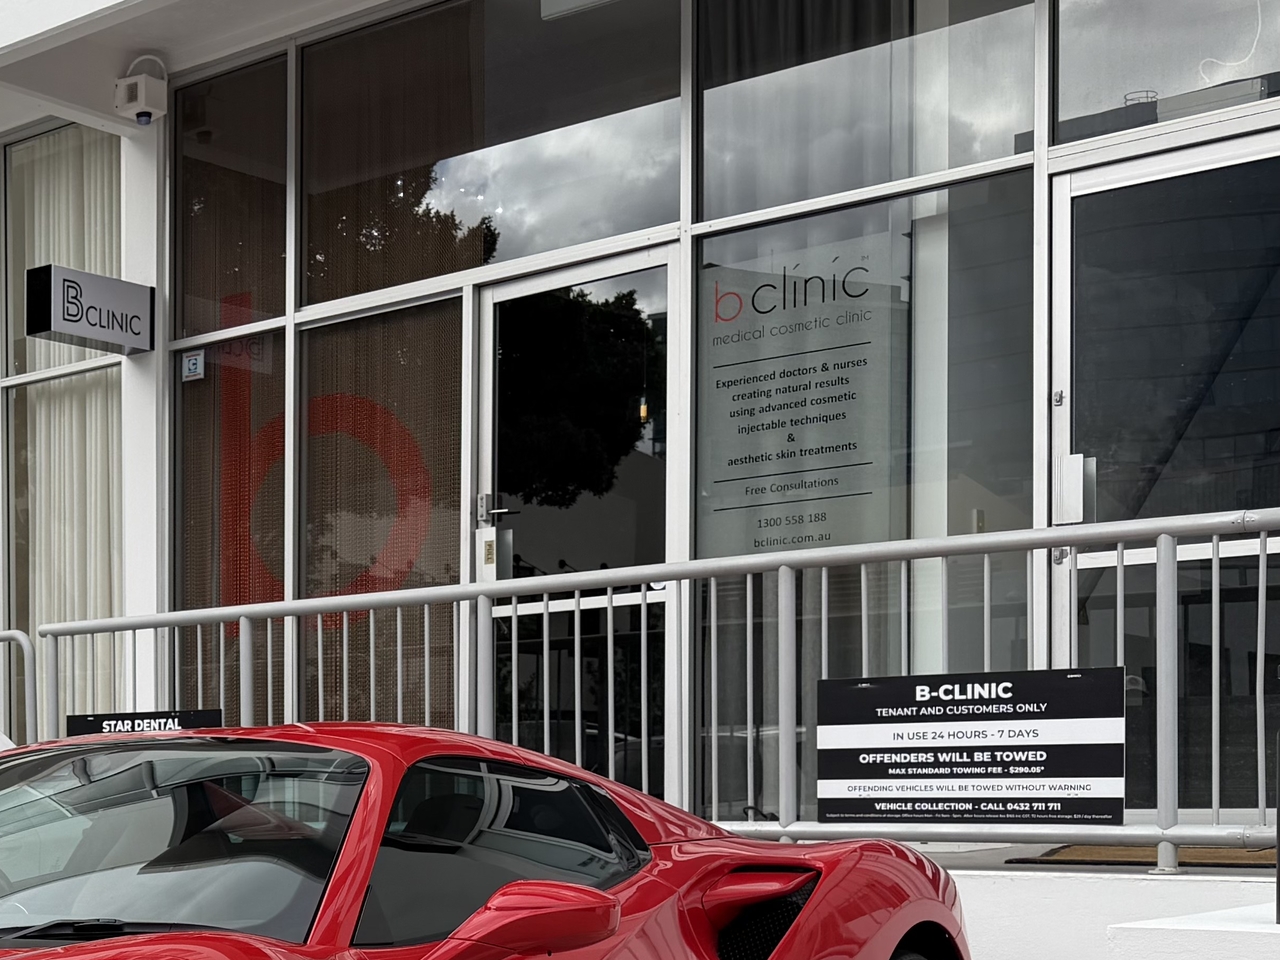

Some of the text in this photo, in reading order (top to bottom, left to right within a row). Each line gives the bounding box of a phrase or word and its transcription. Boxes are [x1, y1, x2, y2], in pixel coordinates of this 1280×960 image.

[713, 310, 872, 346] medical cosmetic clinic
[716, 358, 868, 389] Experienced doctors & nurses
[732, 376, 850, 402] creating natural results
[729, 391, 857, 418] using advanced cosmetic
[737, 411, 847, 435] injectable techniques
[787, 433, 796, 443] &
[728, 441, 857, 466] aesthetic skin treatments
[745, 477, 839, 496] Free Consultations
[758, 512, 827, 528] 1300 558 188
[754, 532, 831, 548] bclinic.com.au
[915, 682, 1013, 701] B-CLINIC
[876, 703, 1047, 717] TENANT AND CUSTOMERS ONLY
[102, 718, 182, 732] STAR DENTAL
[893, 732, 904, 741] IN
[907, 731, 928, 740] USE
[931, 731, 945, 740] 24
[947, 730, 988, 740] HOURS
[997, 730, 1005, 738] 7
[1008, 729, 1039, 739] DAYS
[859, 751, 1047, 764] OFFENDERS WILL BE TOWED
[908, 767, 951, 775] STANDARD
[952, 767, 986, 775] TOWING
[1005, 784, 1045, 792] WITHOUT
[875, 803, 913, 811] VEHICLE
[915, 802, 973, 811] COLLECTION
[980, 803, 1005, 811] CALL
[1007, 803, 1030, 811] 0432
[1032, 803, 1046, 811] 711
[1047, 803, 1061, 811] 711
